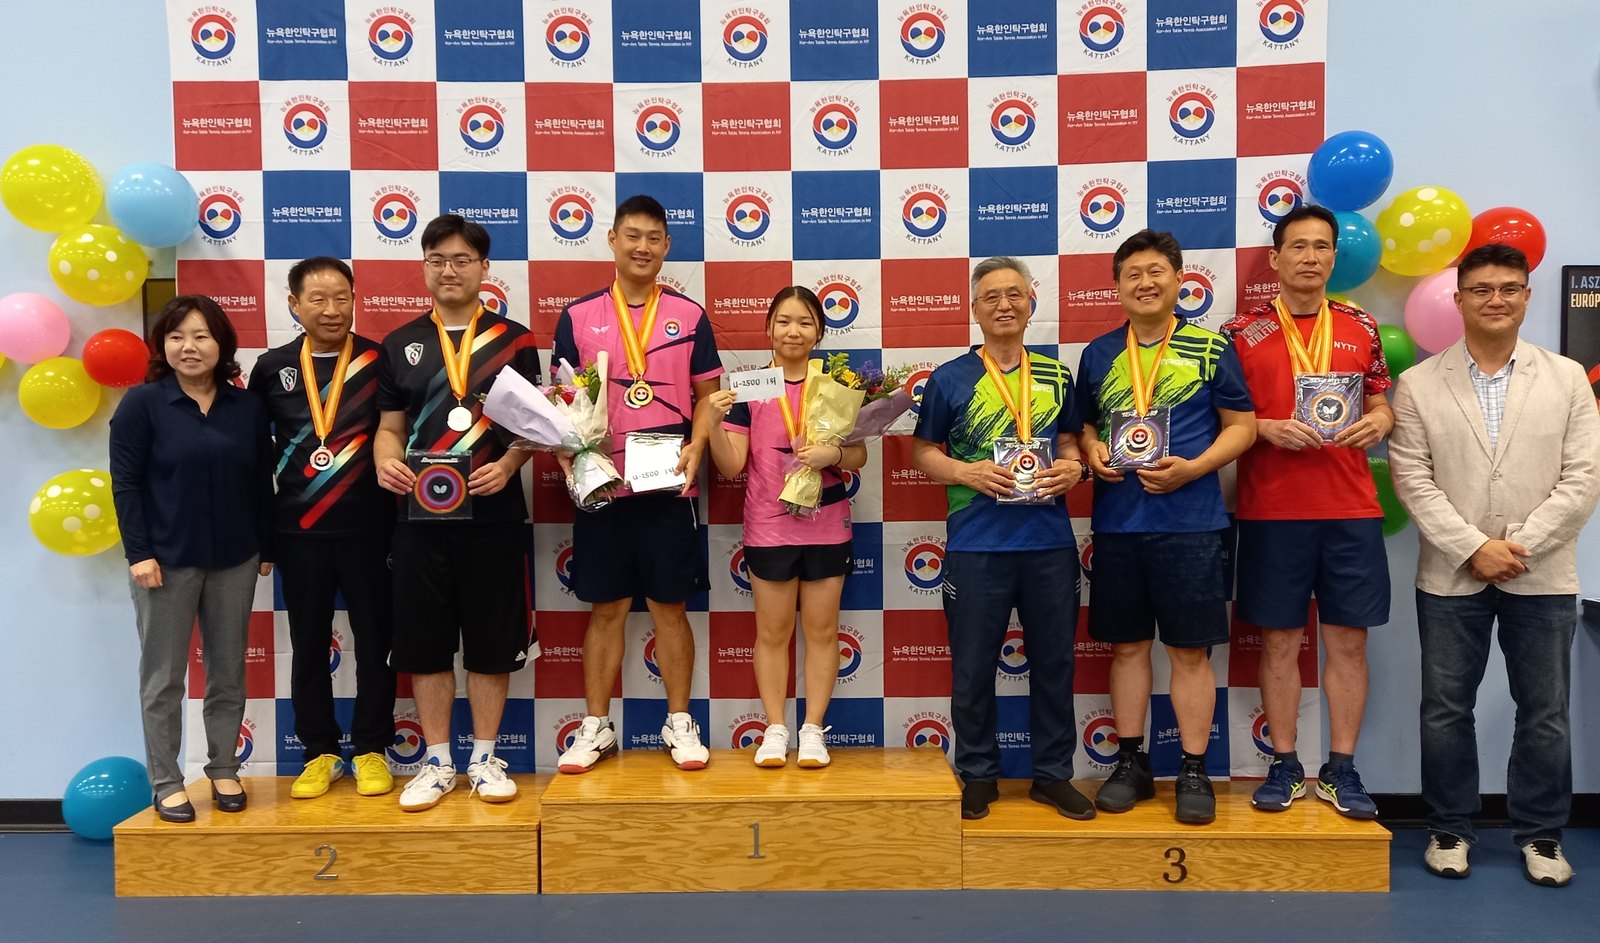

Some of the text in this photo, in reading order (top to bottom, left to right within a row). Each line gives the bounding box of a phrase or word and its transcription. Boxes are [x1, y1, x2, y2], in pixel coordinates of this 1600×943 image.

[1156, 14, 1227, 27] 뉴욕한인탁구협회
[266, 27, 336, 38] 뉴욕한인탁구협회
[444, 29, 514, 39] 뉴욕한인탁구협회
[799, 28, 869, 38] 뉴욕한인탁구협회
[977, 23, 1047, 34] 뉴욕한인탁구협회
[622, 30, 692, 40] 뉴욕한인탁구협회
[1262, 39, 1300, 50] KATTANY
[904, 54, 941, 66] KATTANY
[1083, 48, 1120, 60] KATTANY
[196, 56, 233, 68] KATTANY
[373, 56, 410, 68] KATTANY
[550, 57, 587, 69] KATTANY
[727, 56, 764, 69] KATTANY
[1246, 100, 1316, 113] 뉴욕한인탁구협회
[889, 115, 959, 126] 뉴욕한인탁구협회
[1067, 109, 1138, 121] 뉴욕한인탁구협회
[182, 118, 252, 128] 뉴욕한인탁구협회
[358, 118, 428, 128] 뉴욕한인탁구협회
[535, 119, 604, 129] 뉴욕한인탁구협회
[712, 118, 781, 129] 뉴욕한인탁구협회
[1173, 134, 1210, 146] KATTANY
[288, 144, 324, 156] KATTANY
[464, 146, 500, 158] KATTANY
[640, 147, 677, 159] KATTANY
[816, 145, 853, 157] KATTANY
[994, 142, 1031, 153] KATTANY
[198, 185, 244, 204] 욕한인탁구협회
[1156, 196, 1227, 207] 뉴욕한인탁구협회
[272, 207, 342, 216] 뉴욕한인탁구협회
[801, 207, 871, 217] 뉴욕한인탁구협회
[978, 203, 1048, 214] 뉴욕한인탁구협회
[376, 234, 414, 246] KATTANY
[905, 233, 943, 246] KATTANY
[1084, 228, 1121, 240] KATTANY
[200, 235, 237, 247] KATTANY
[553, 235, 590, 247] KATTANY
[730, 235, 767, 247] KATTANY
[1184, 264, 1217, 281] 인탁구협회
[1245, 282, 1280, 294] 뉴욕한인
[363, 296, 432, 306] 뉴욕한인탁구협회
[890, 295, 960, 305] 뉴욕한인탁구협회
[1068, 290, 1118, 300] 뉴욕한인탁구
[1571, 291, 1600, 308] EURÓP
[824, 325, 855, 336] ATTANY
[1247, 320, 1279, 348] ATHLETIC
[1334, 341, 1357, 352] NYTT
[838, 674, 857, 685] TANY
[747, 822, 766, 859] 1
[313, 844, 338, 880] 2
[1163, 847, 1188, 883] 3
